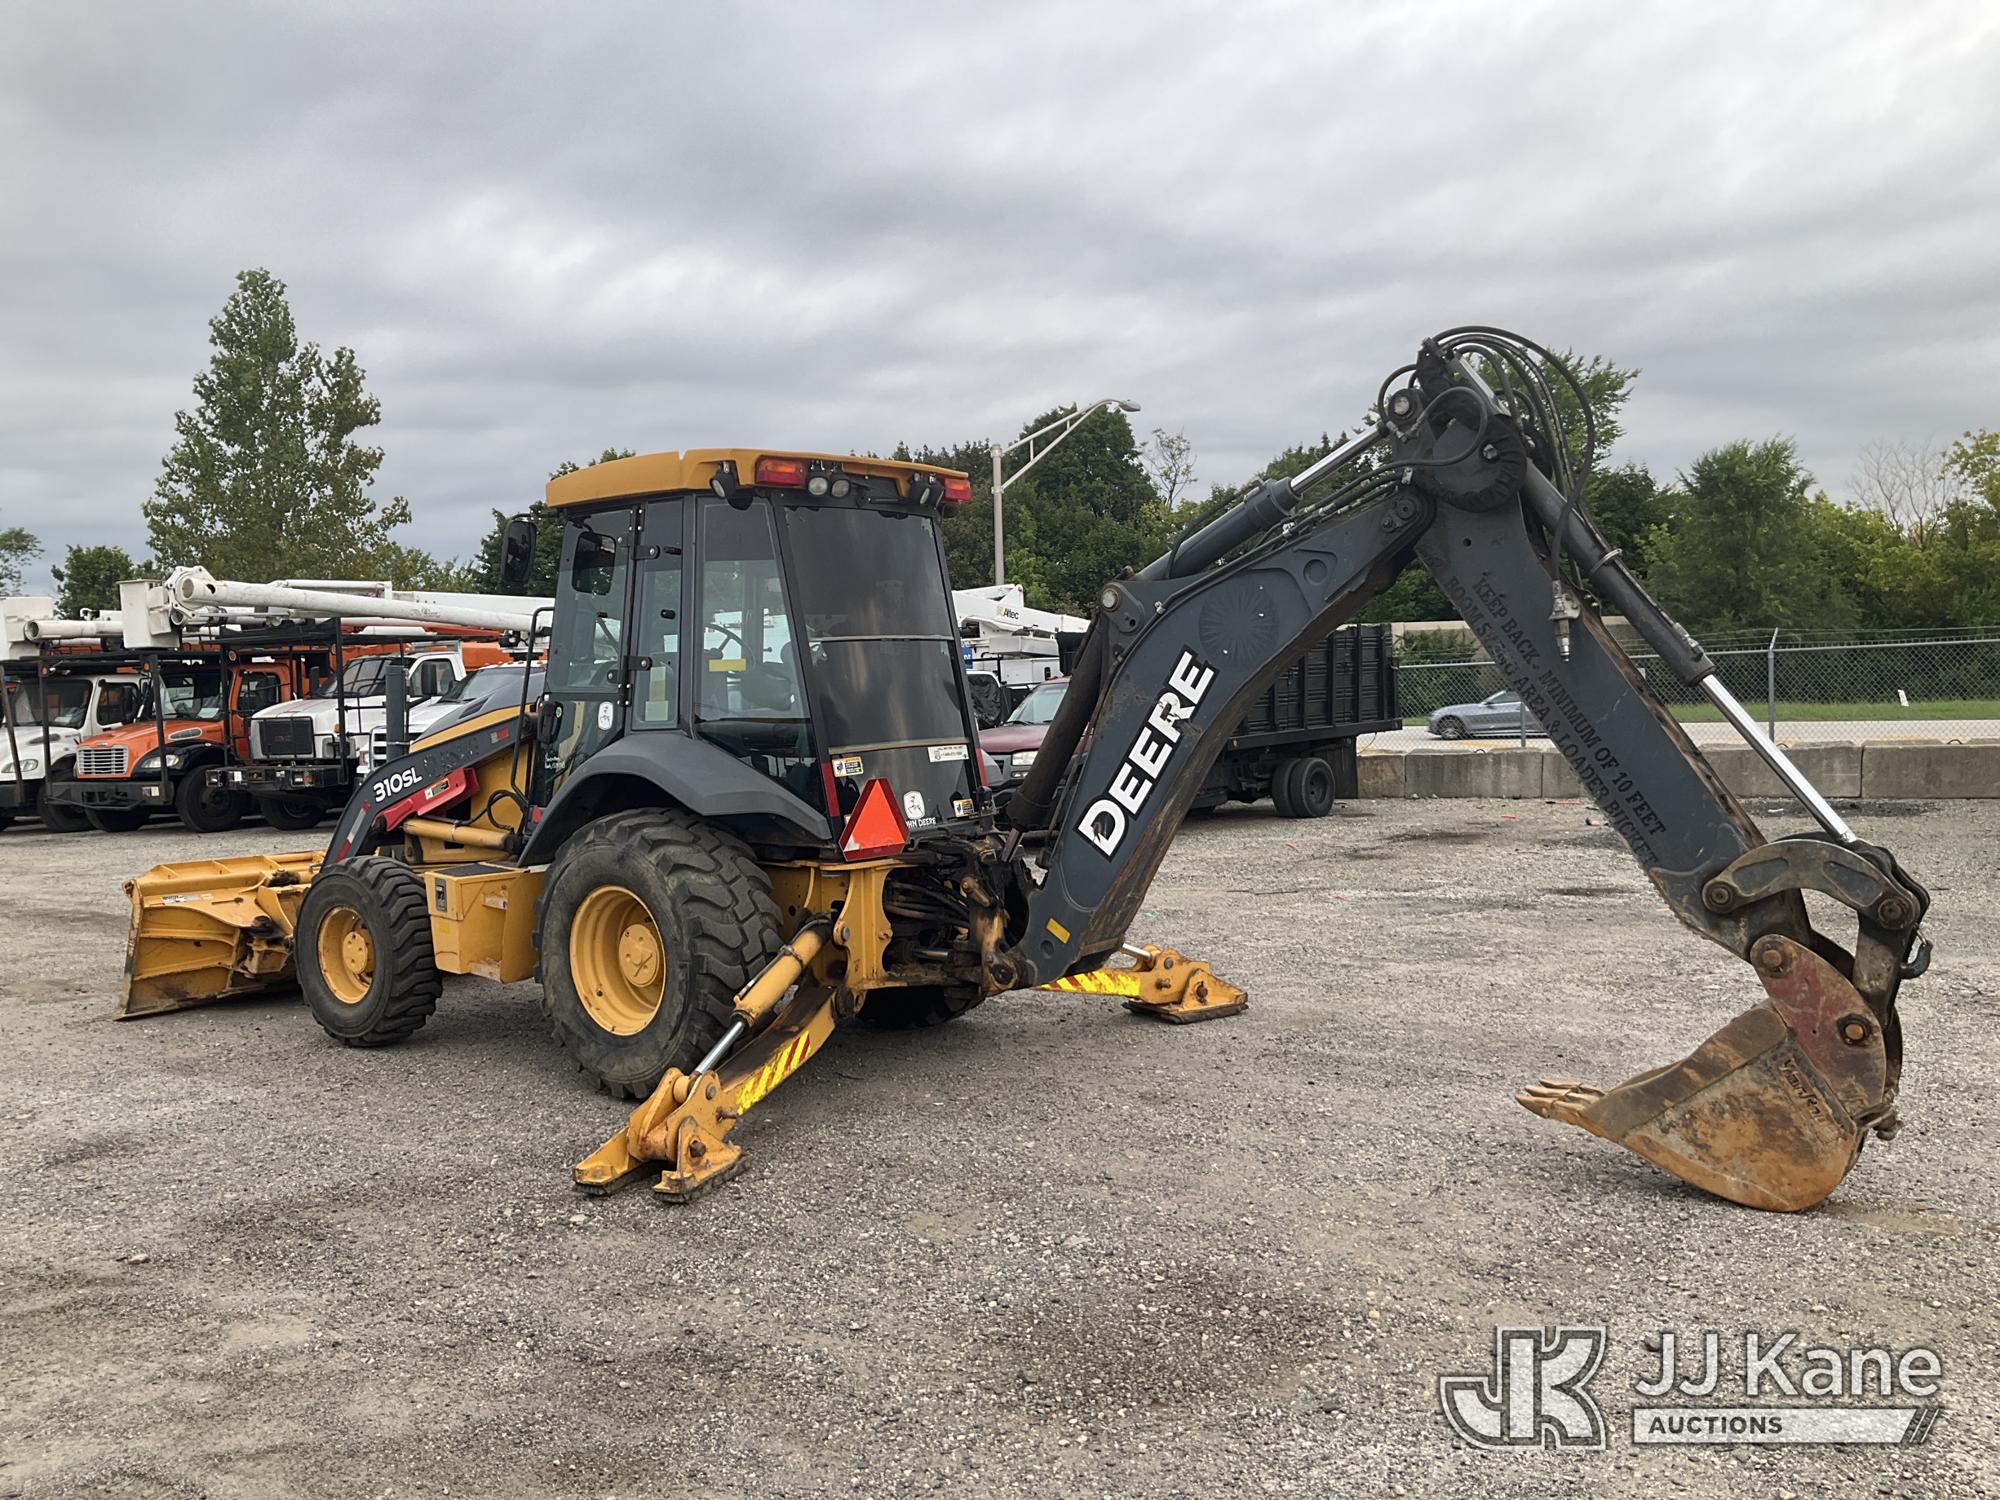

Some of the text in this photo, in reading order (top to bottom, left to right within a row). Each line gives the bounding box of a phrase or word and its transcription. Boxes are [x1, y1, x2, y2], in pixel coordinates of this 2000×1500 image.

[373, 767, 422, 802] 310SL
[1078, 651, 1215, 856] DEERE
[1472, 578, 1509, 618] KEEP
[1501, 618, 1541, 664] BACK
[1538, 670, 1601, 748] MINIMUM
[1593, 745, 1620, 769] OF
[1612, 771, 1634, 794] 10
[1625, 790, 1667, 835] FEET
[1513, 675, 1553, 722] AREA
[1545, 718, 1564, 735] &
[1555, 733, 1611, 801] LOADER
[1603, 800, 1659, 866] BUCKET
[918, 817, 936, 827] DEERE
